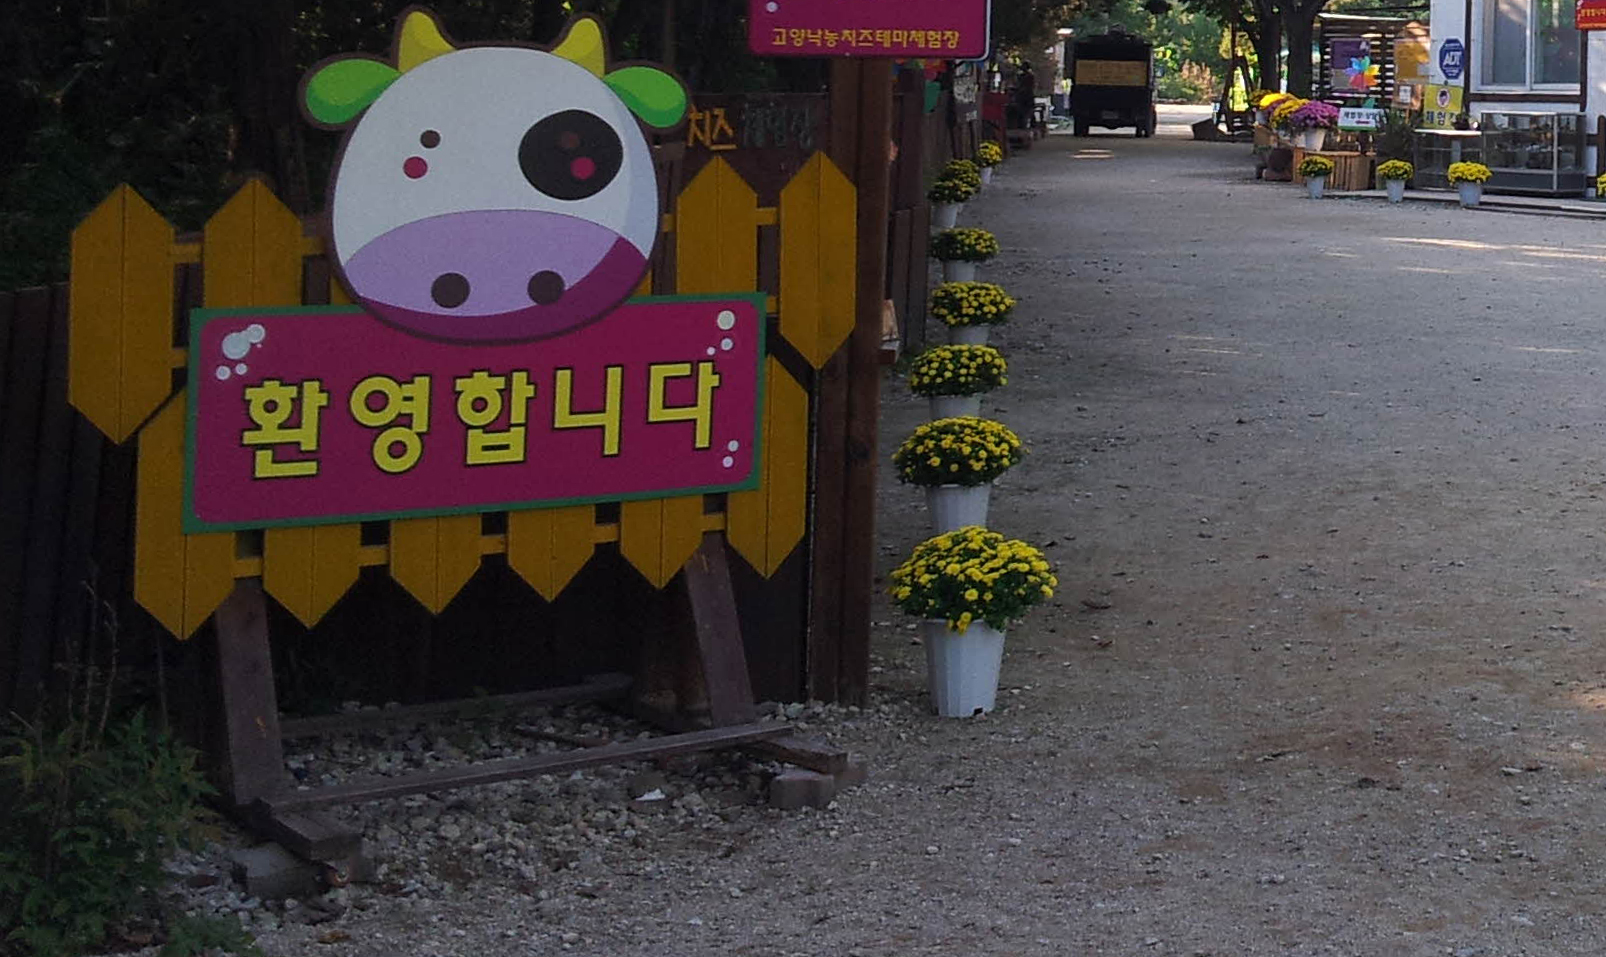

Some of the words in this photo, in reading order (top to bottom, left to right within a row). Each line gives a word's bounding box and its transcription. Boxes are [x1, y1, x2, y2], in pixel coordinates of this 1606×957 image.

[771, 27, 960, 49] 고양낙농치즈테마체험장
[1443, 51, 1463, 66] ADT
[241, 360, 722, 479] 환영합니다
